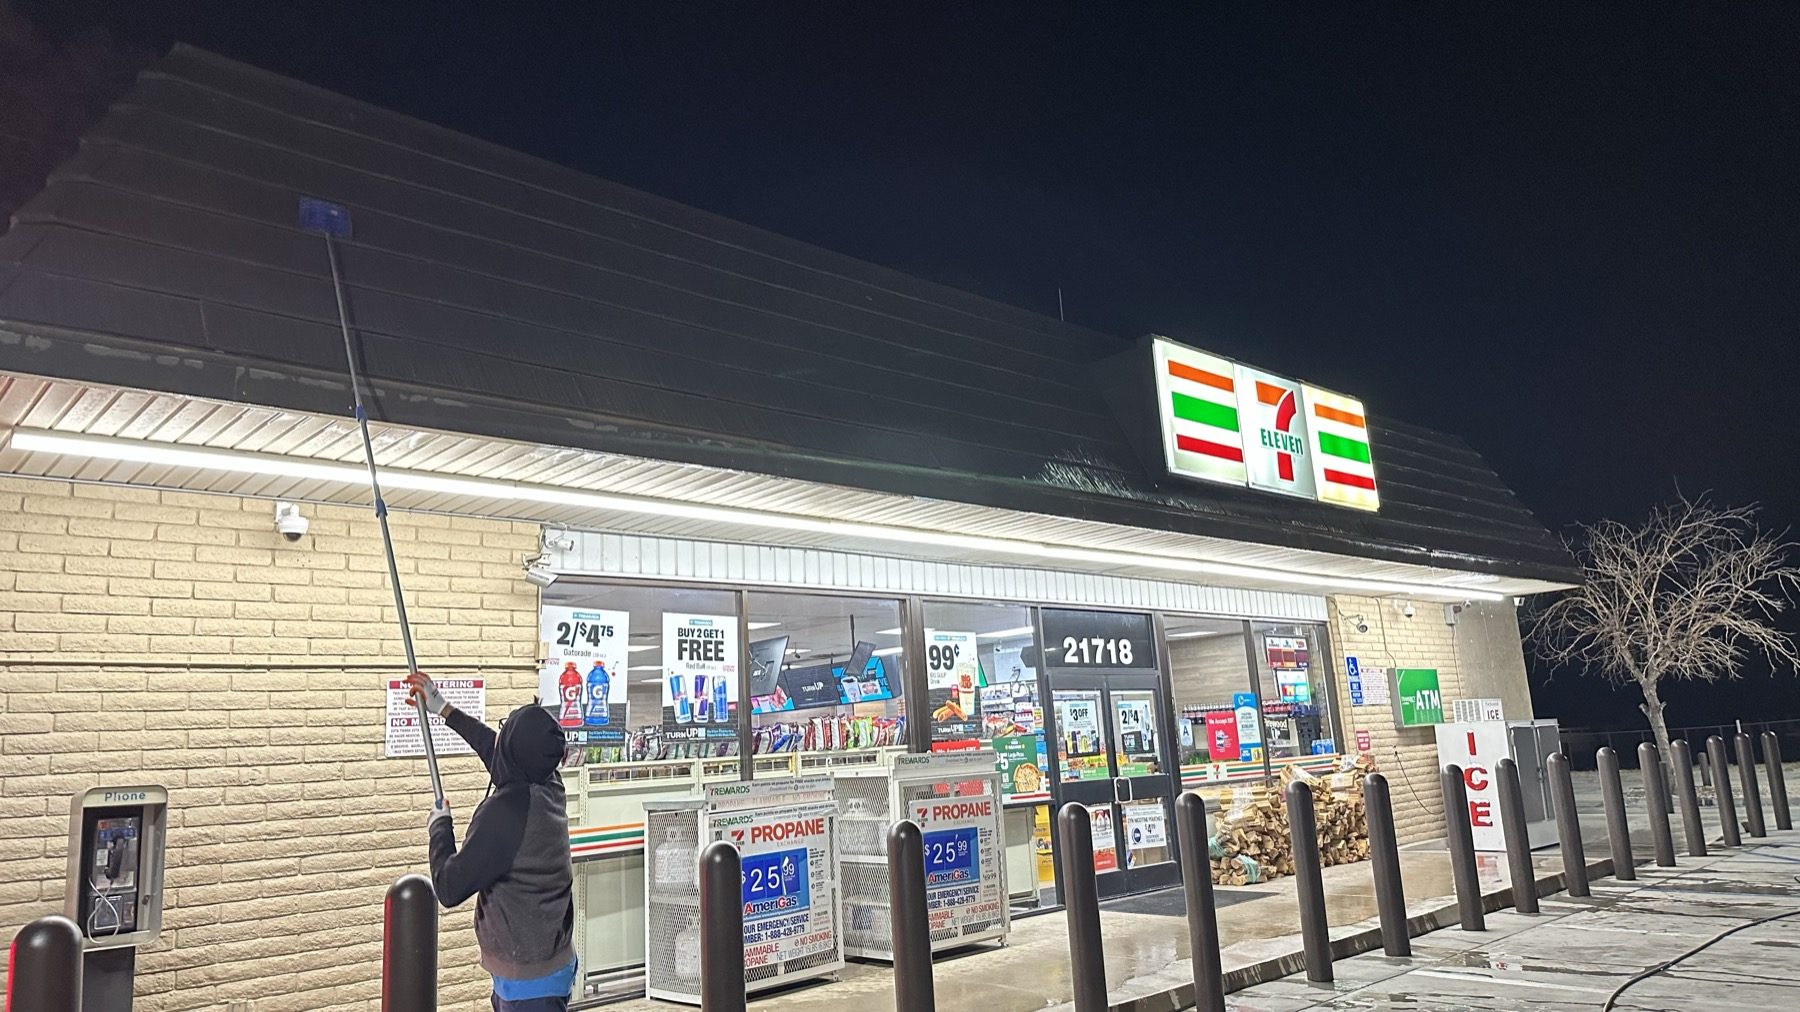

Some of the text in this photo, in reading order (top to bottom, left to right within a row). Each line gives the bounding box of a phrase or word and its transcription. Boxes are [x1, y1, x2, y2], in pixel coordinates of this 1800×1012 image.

[1255, 380, 1297, 481] 7
[677, 627, 724, 639] BUY 2 GET 1
[564, 648, 591, 657] Gatorade
[678, 639, 725, 662] FREE
[1063, 637, 1133, 665] 21718
[565, 686, 576, 700] G
[592, 685, 603, 699] G
[1416, 690, 1440, 710] ATM
[1079, 708, 1088, 718] OFF
[1487, 709, 1500, 720] ICE
[392, 718, 408, 726] NO
[565, 731, 578, 742] UP
[1183, 725, 1190, 737] A
[1464, 732, 1493, 827] ICE
[105, 792, 146, 802] Phone
[933, 801, 991, 821] PROPANE
[751, 818, 825, 844] PROPANE
[928, 869, 969, 884] AmeriGas
[744, 896, 797, 915] AmeriGas
[971, 902, 999, 914] NO SMOKING
[928, 910, 954, 921] AMMABLE
[744, 924, 756, 934] OUR
[757, 918, 789, 931] EMERGENCY
[791, 913, 809, 926] SERVICE
[744, 933, 764, 944] MBER:
[800, 931, 831, 945] NO SMOKING
[745, 943, 779, 958] AMMABLE
[745, 955, 768, 967] OPANE
